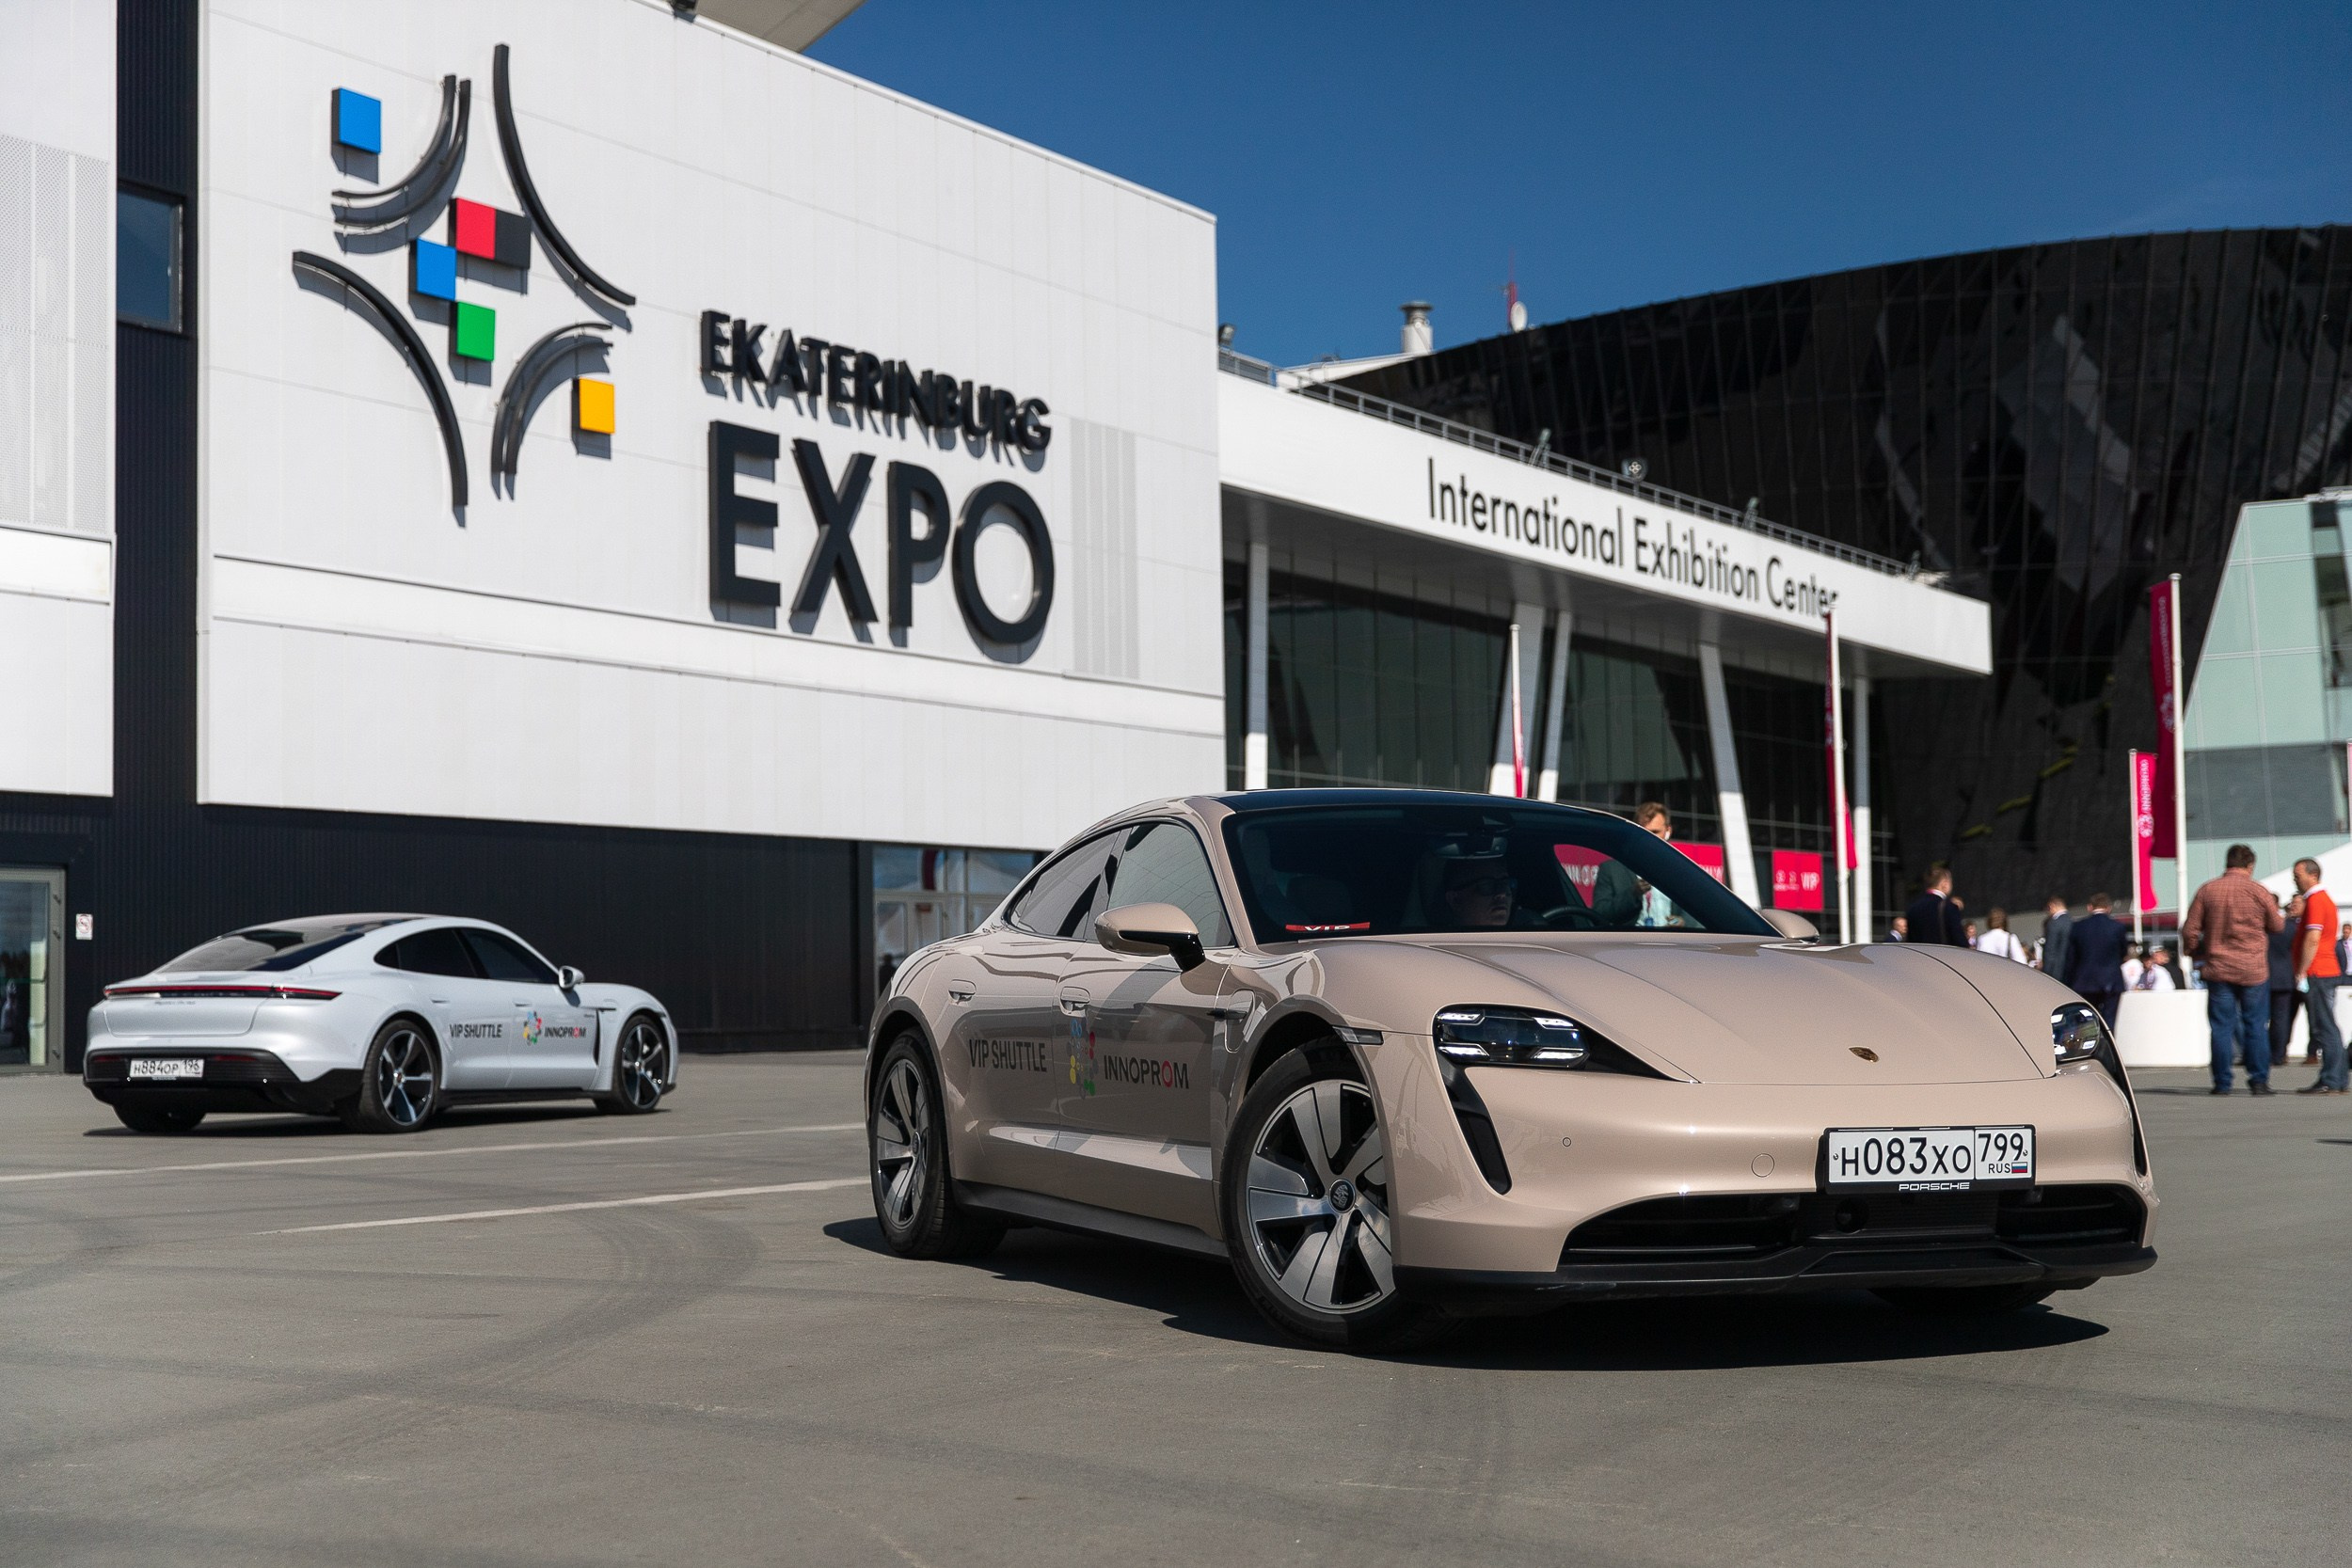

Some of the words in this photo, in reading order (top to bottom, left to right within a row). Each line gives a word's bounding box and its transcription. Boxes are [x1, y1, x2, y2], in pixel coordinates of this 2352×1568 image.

[700, 309, 1053, 453] EKATERINBURG
[707, 419, 1056, 646] EXPO
[1427, 456, 1624, 568] International
[1633, 515, 1760, 602] Exhibition
[1766, 556, 1837, 620] Center
[450, 1023, 463, 1038] VIP
[464, 1023, 502, 1038] SHUTTLE
[544, 1026, 587, 1038] INNOPROM
[969, 1038, 989, 1069] VIP
[992, 1039, 1048, 1073] SHUTTLE
[1104, 1054, 1190, 1089] INNOPROM
[1978, 1132, 2025, 1163] 799
[1988, 1163, 2010, 1174] RUS
[1899, 1181, 1971, 1192] PORSCHE
